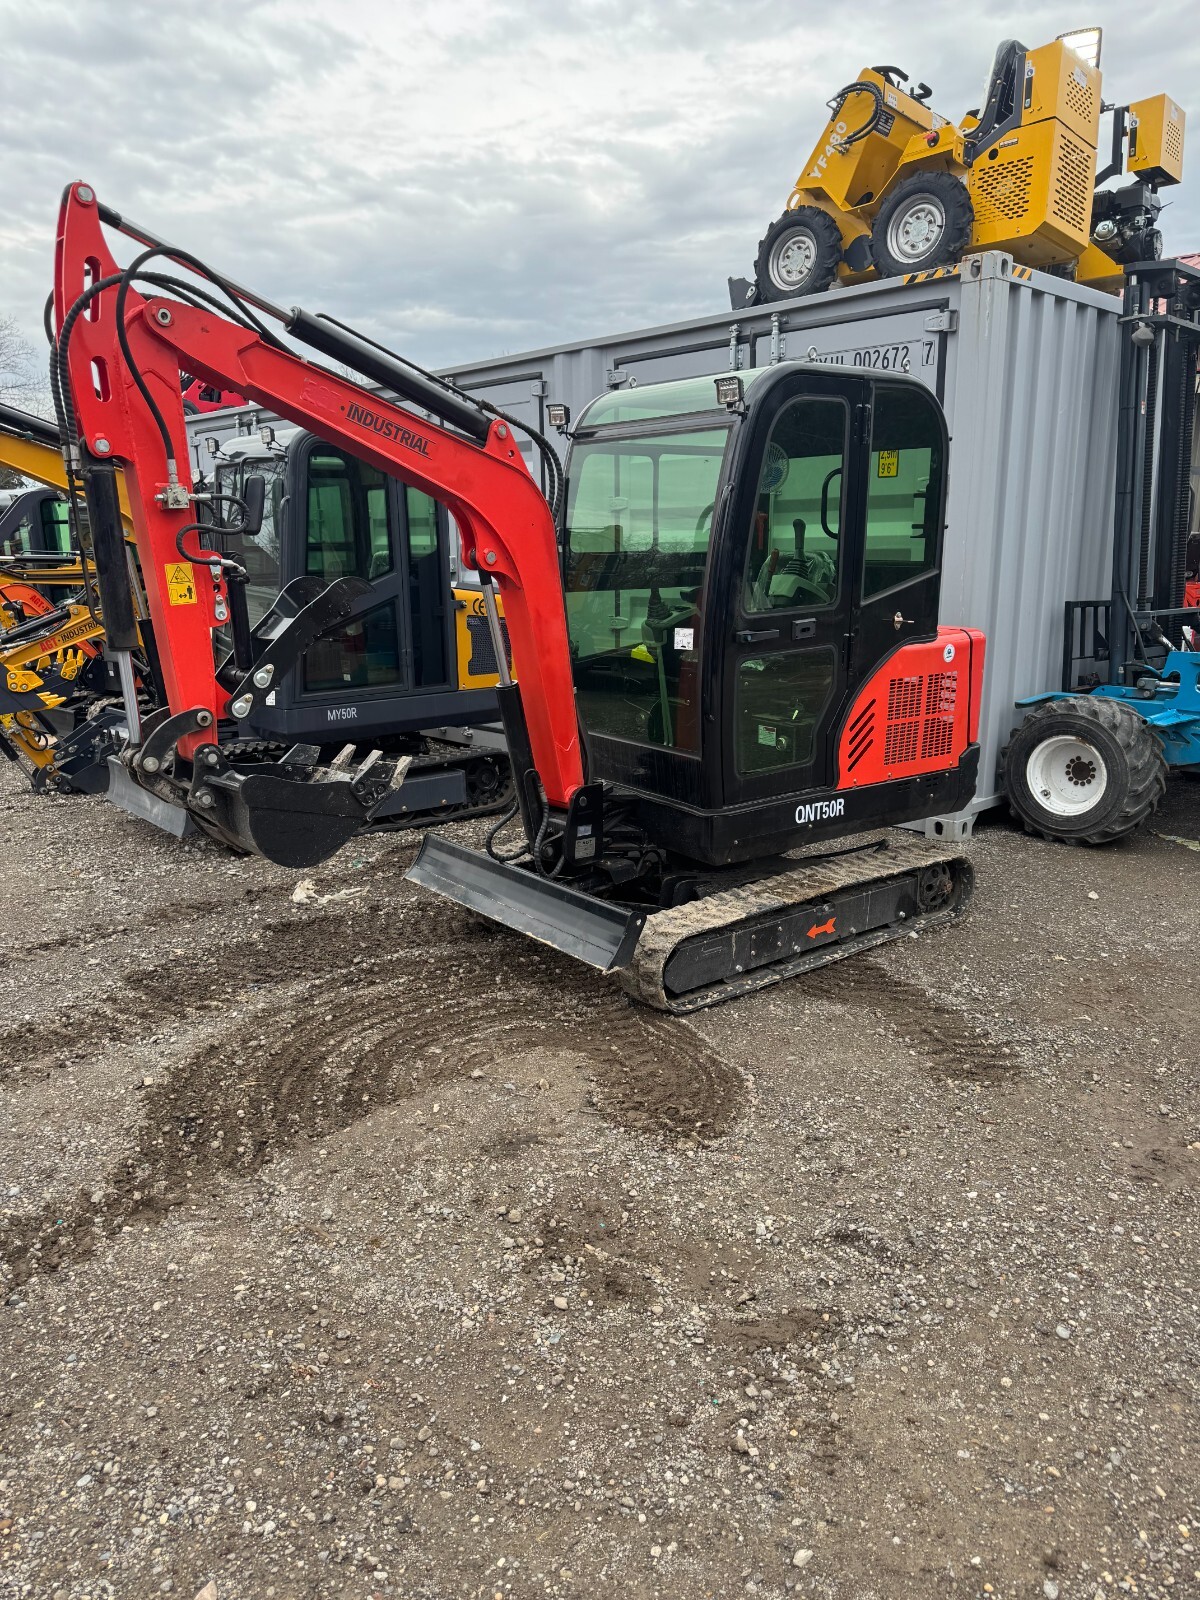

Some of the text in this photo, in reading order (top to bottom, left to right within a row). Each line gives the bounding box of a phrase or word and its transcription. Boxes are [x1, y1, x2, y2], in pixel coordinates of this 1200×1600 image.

[809, 121, 847, 178] YF480
[854, 345, 910, 369] 002672
[924, 342, 934, 365] 7
[346, 403, 430, 456] INDUSTRIAL
[29, 594, 45, 608] AGT
[40, 637, 58, 652] AGT
[327, 707, 358, 721] MY50R
[795, 798, 845, 824] QNT50R
